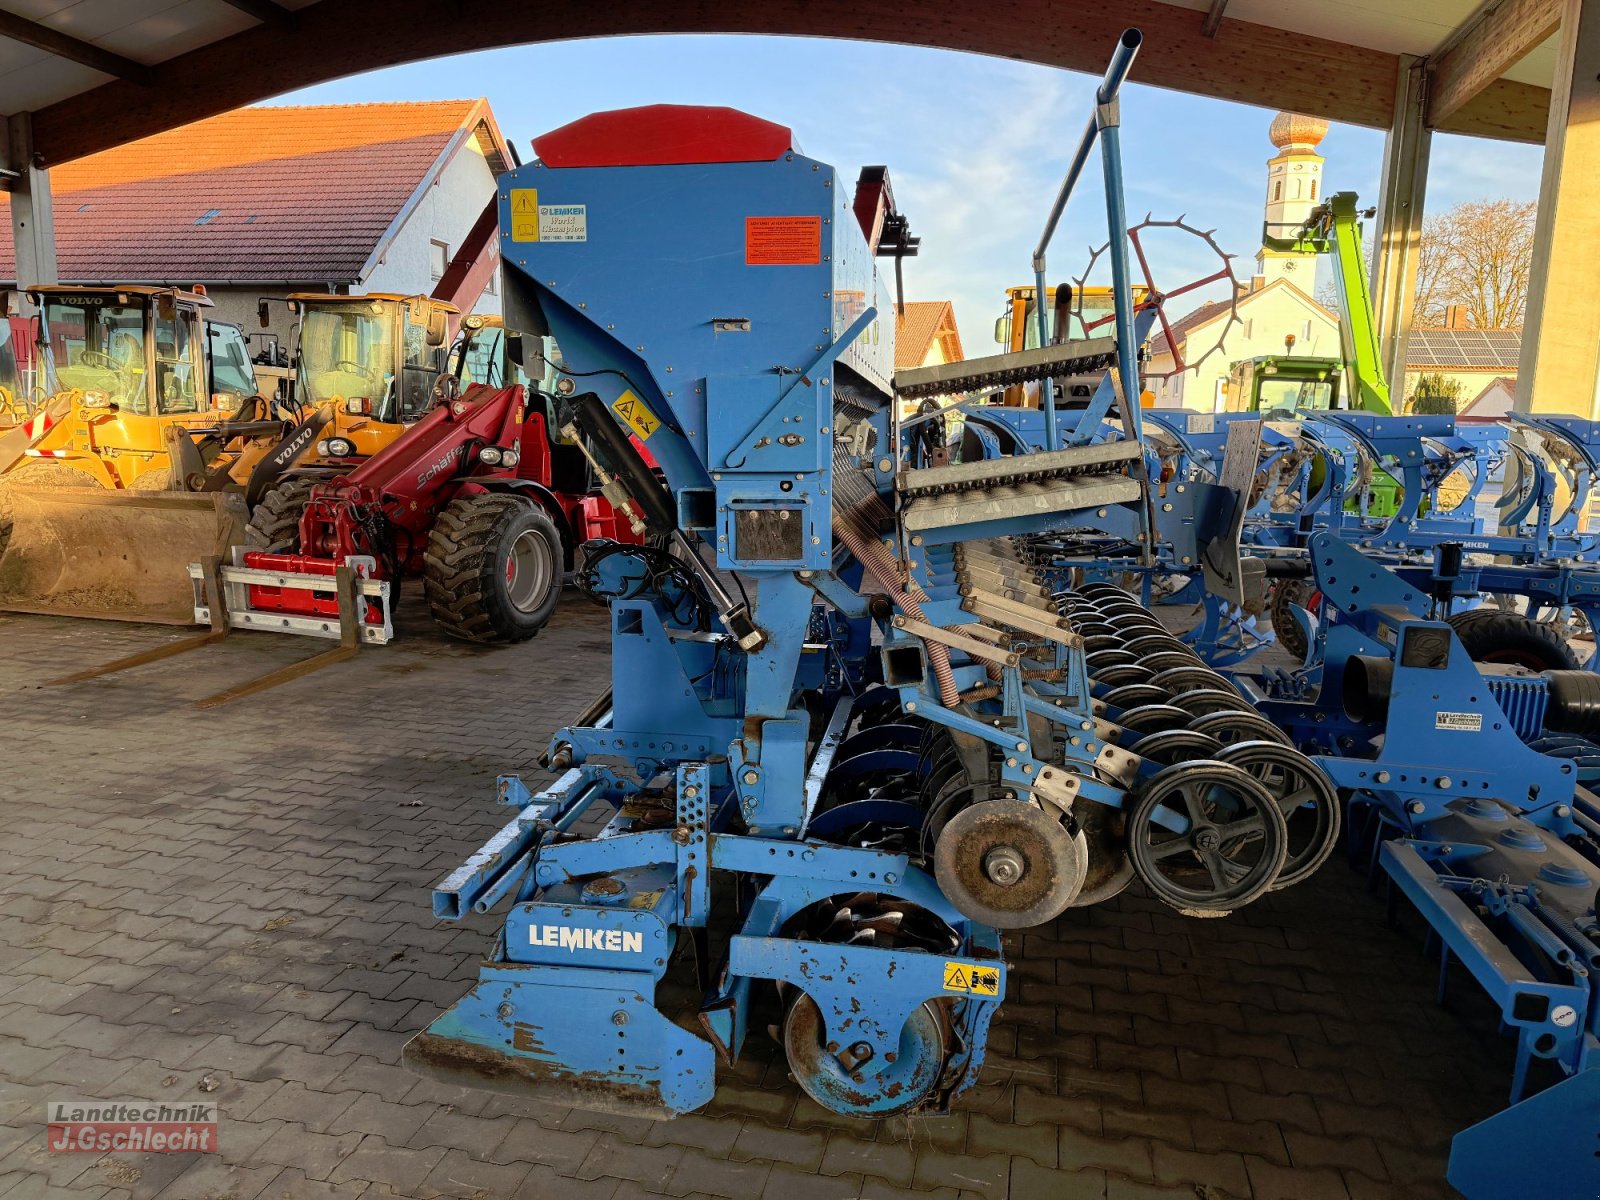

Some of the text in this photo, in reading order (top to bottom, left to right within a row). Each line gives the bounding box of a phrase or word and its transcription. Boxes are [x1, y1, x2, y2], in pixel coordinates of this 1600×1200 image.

[549, 207, 585, 216] LEMKEN
[59, 297, 103, 305] VOLVO
[274, 427, 312, 465] VOLVO
[529, 924, 643, 954] LEMKEN
